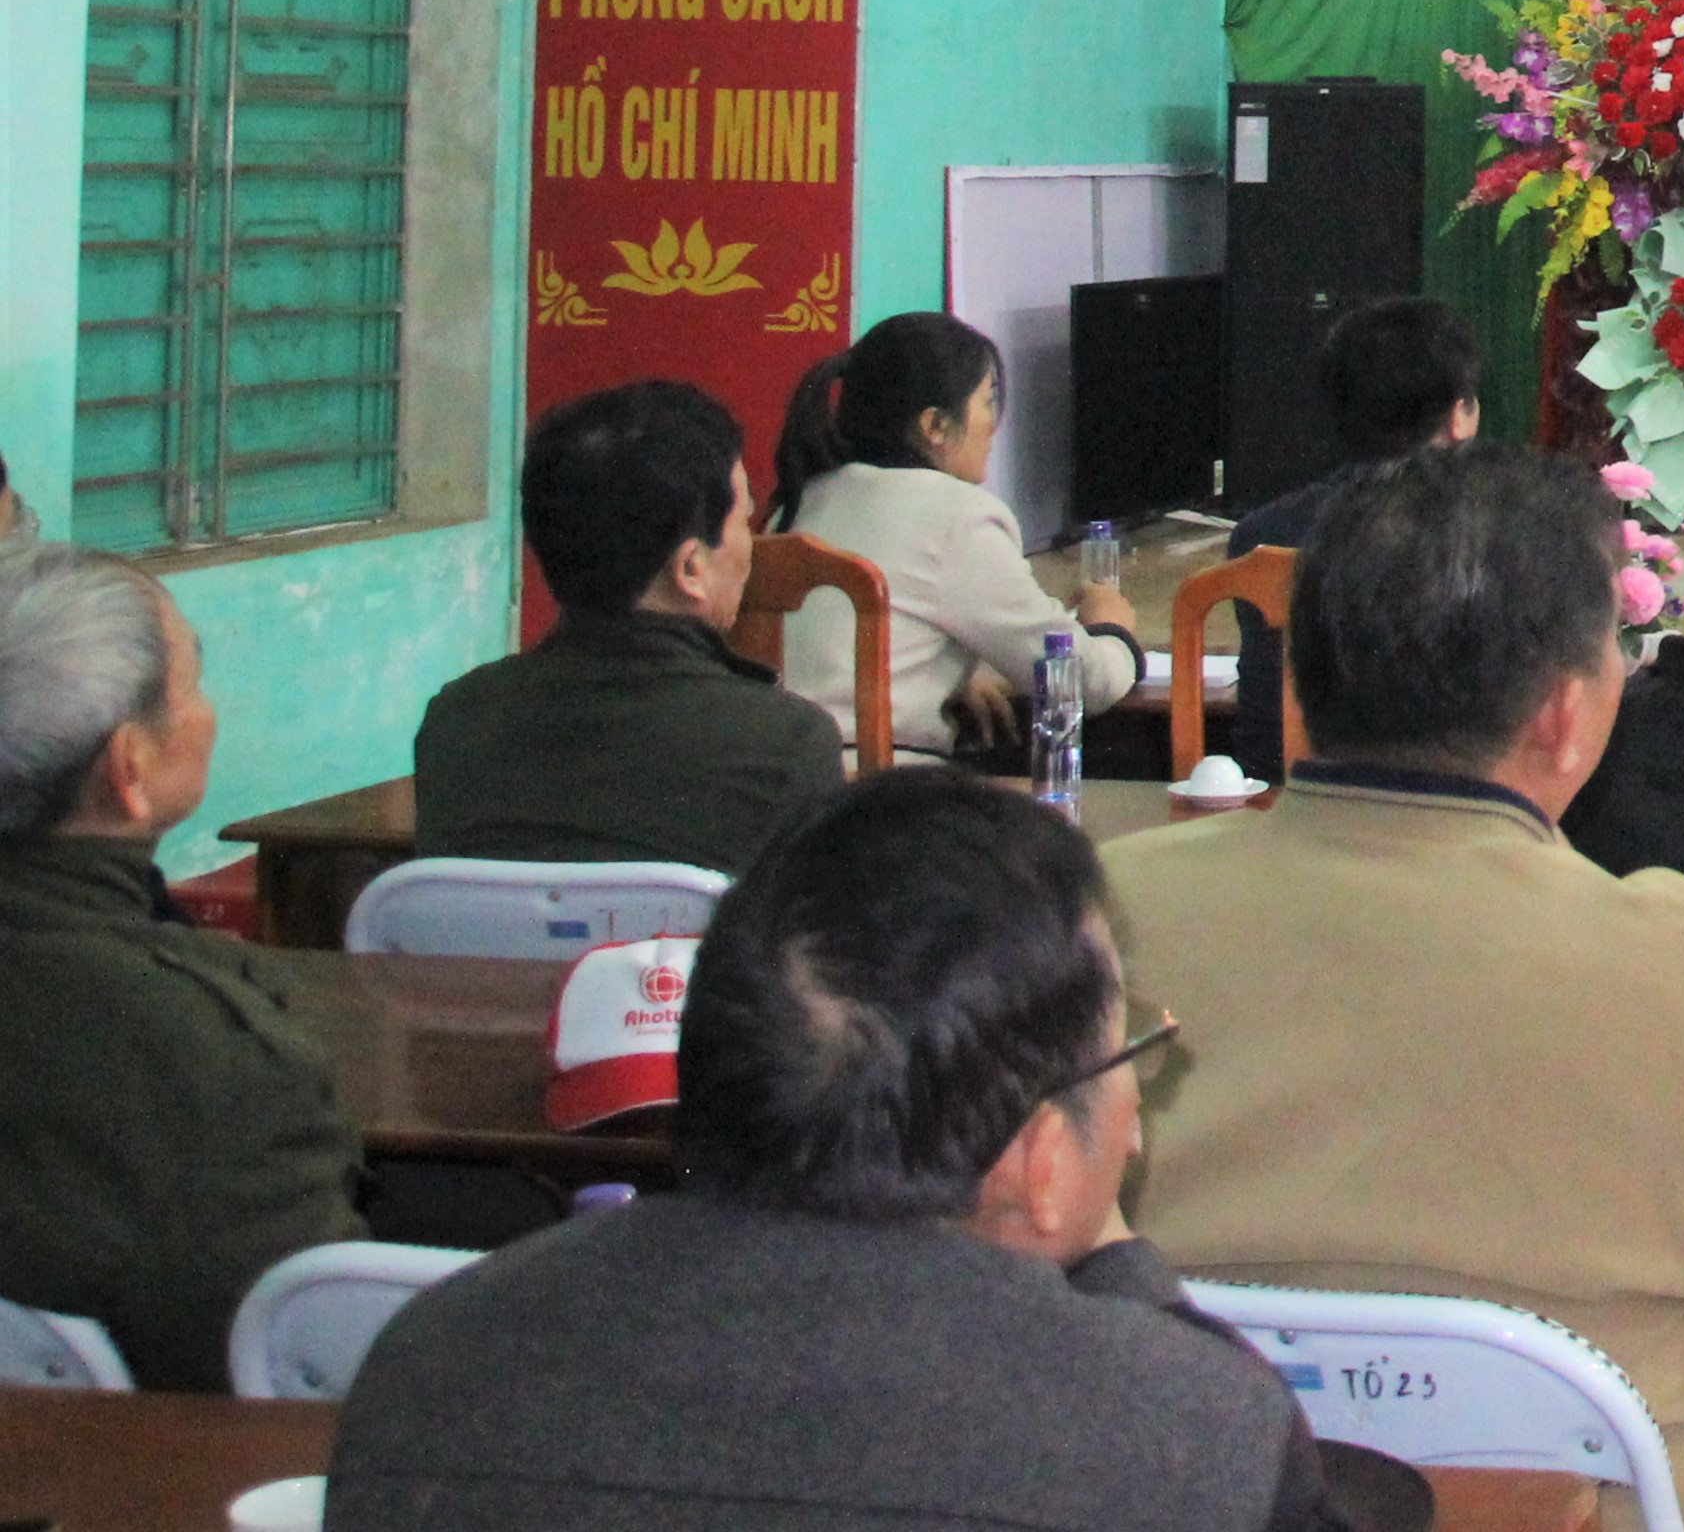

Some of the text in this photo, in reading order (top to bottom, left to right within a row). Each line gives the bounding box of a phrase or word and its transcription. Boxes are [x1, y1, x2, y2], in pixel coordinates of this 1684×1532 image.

[544, 56, 840, 184] HỒ CHÍ MINH
